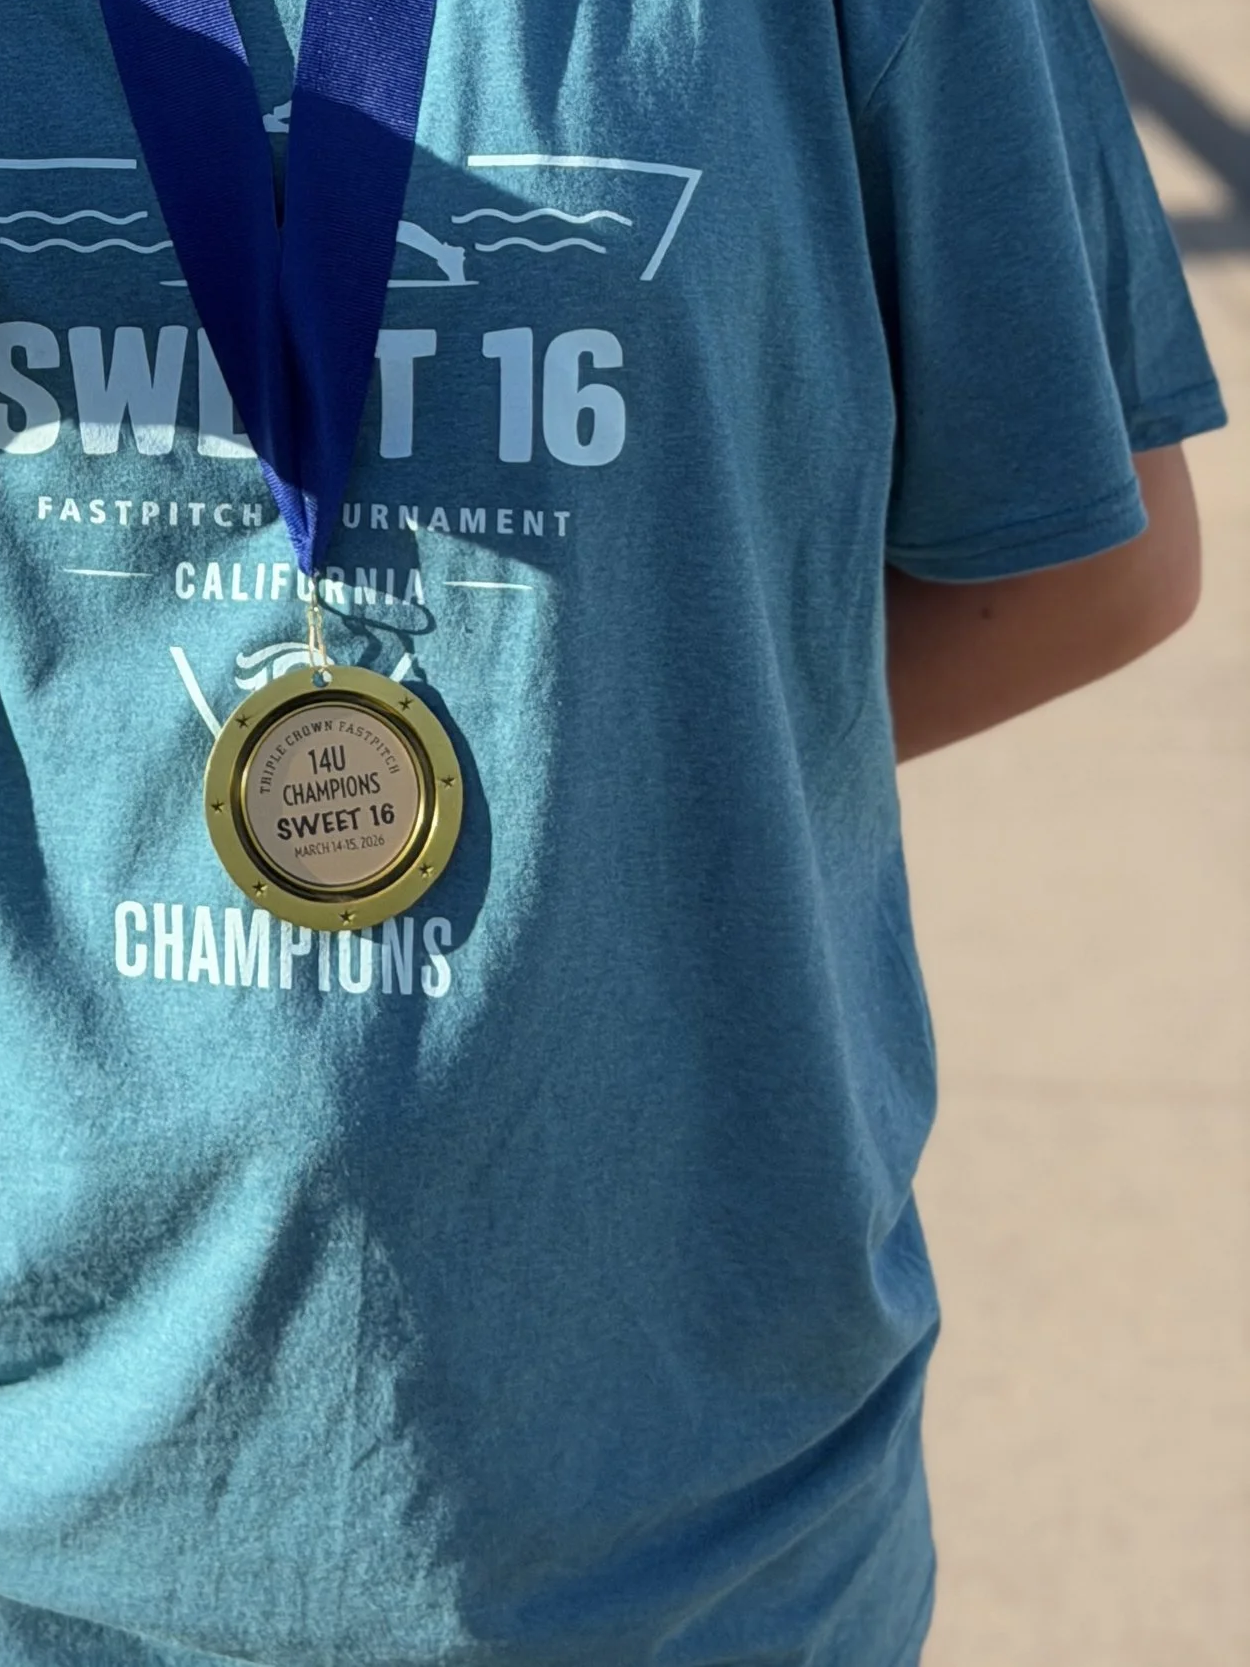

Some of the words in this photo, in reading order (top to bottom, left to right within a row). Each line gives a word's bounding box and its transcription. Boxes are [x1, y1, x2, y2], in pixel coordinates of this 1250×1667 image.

[482, 327, 626, 467] 16
[37, 495, 263, 528] FASTPITCH
[342, 502, 571, 538] URNAMENT
[260, 744, 287, 794] TRIPLE
[285, 720, 333, 746] CROWN
[339, 721, 400, 774] FASTPITCH
[308, 745, 346, 775] 14U
[283, 772, 381, 807] CHAMPIONS
[277, 807, 361, 841] SWEET
[370, 803, 395, 826] 16
[294, 841, 330, 858] MARCH
[361, 834, 385, 849] 2026
[114, 900, 452, 999] CHAMPIONS
